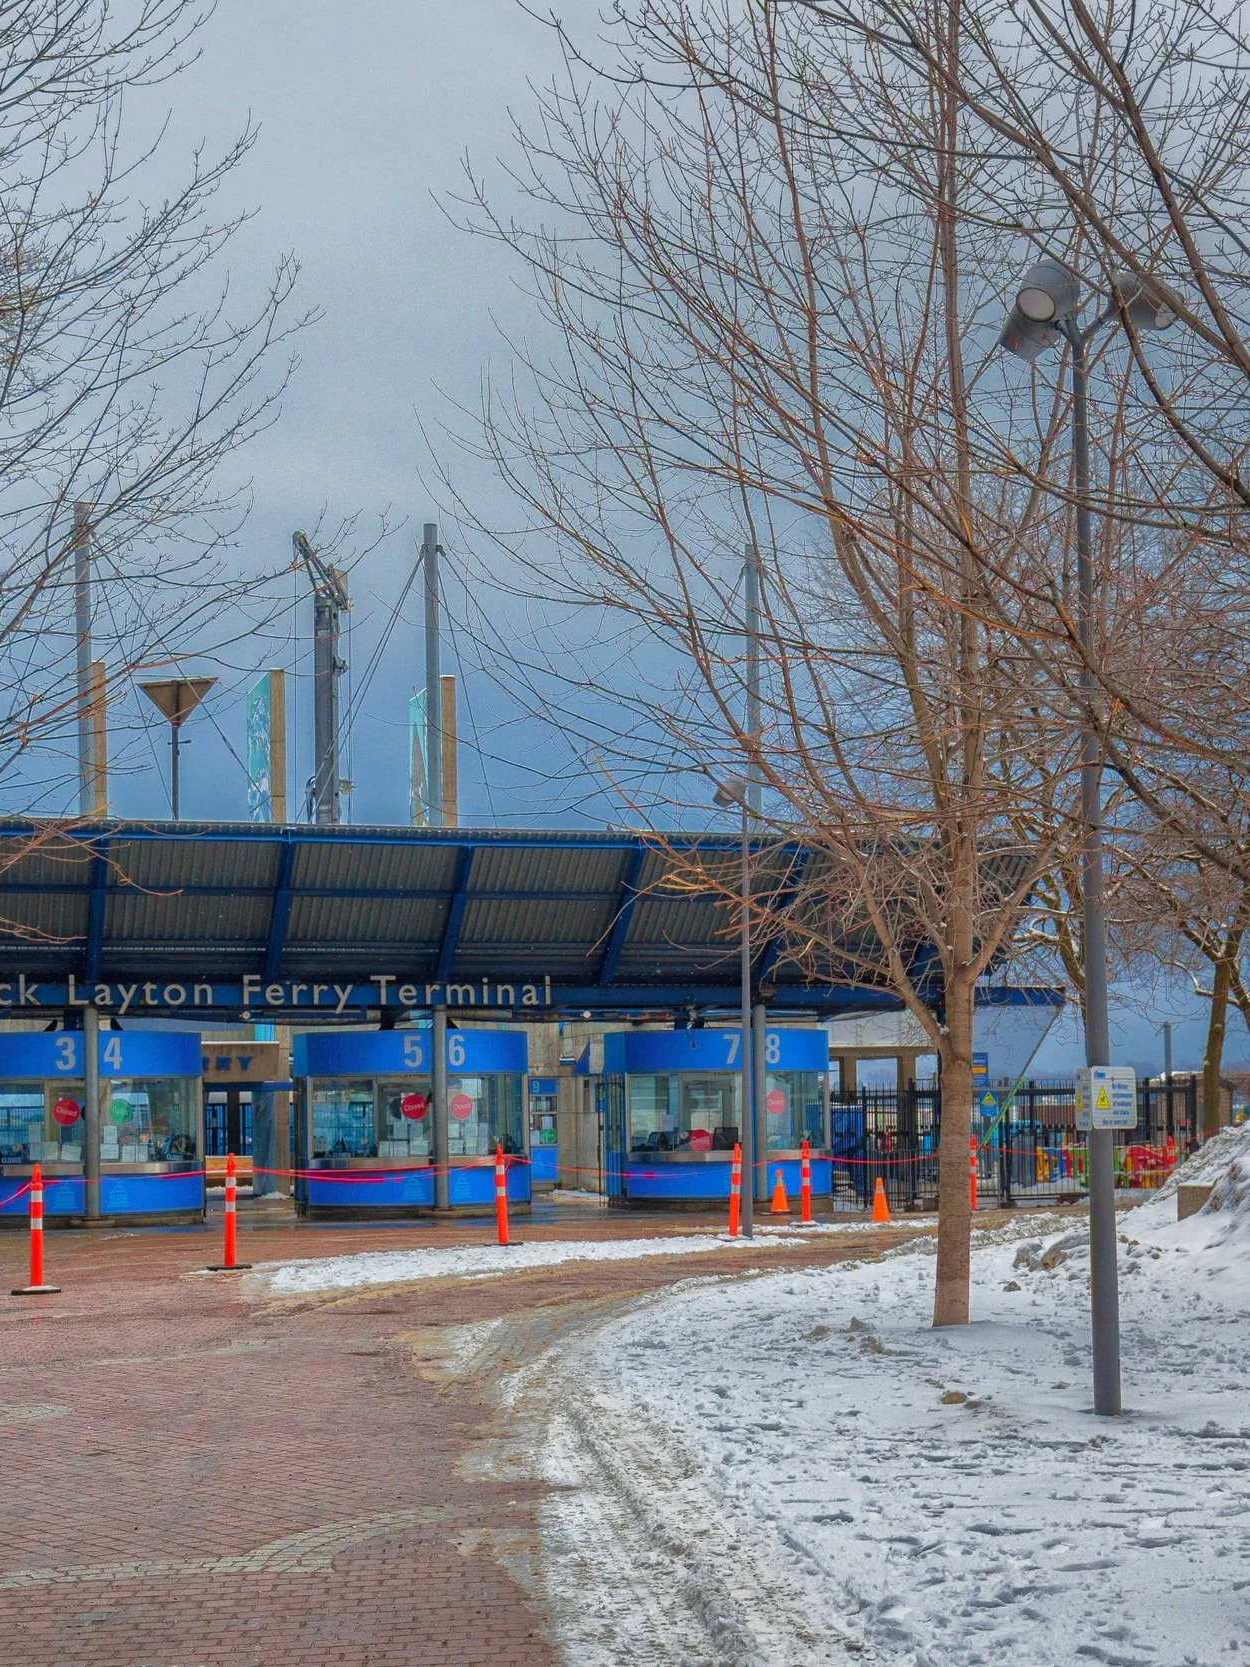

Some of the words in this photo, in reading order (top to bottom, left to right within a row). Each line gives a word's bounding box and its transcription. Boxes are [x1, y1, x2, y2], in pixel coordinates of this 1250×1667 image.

[68, 974, 213, 1014] Layton
[242, 974, 354, 1014] Ferry
[370, 975, 552, 1005] Terminal
[55, 1037, 76, 1071] 3
[103, 1037, 123, 1070] 4
[404, 1035, 423, 1067] 5
[448, 1034, 466, 1067] 6
[723, 1034, 741, 1064] 7
[765, 1033, 781, 1064] 8
[532, 1080, 539, 1093] 9
[55, 1106, 78, 1117] Closed
[404, 1102, 425, 1112] Closed
[452, 1102, 471, 1110] Closed
